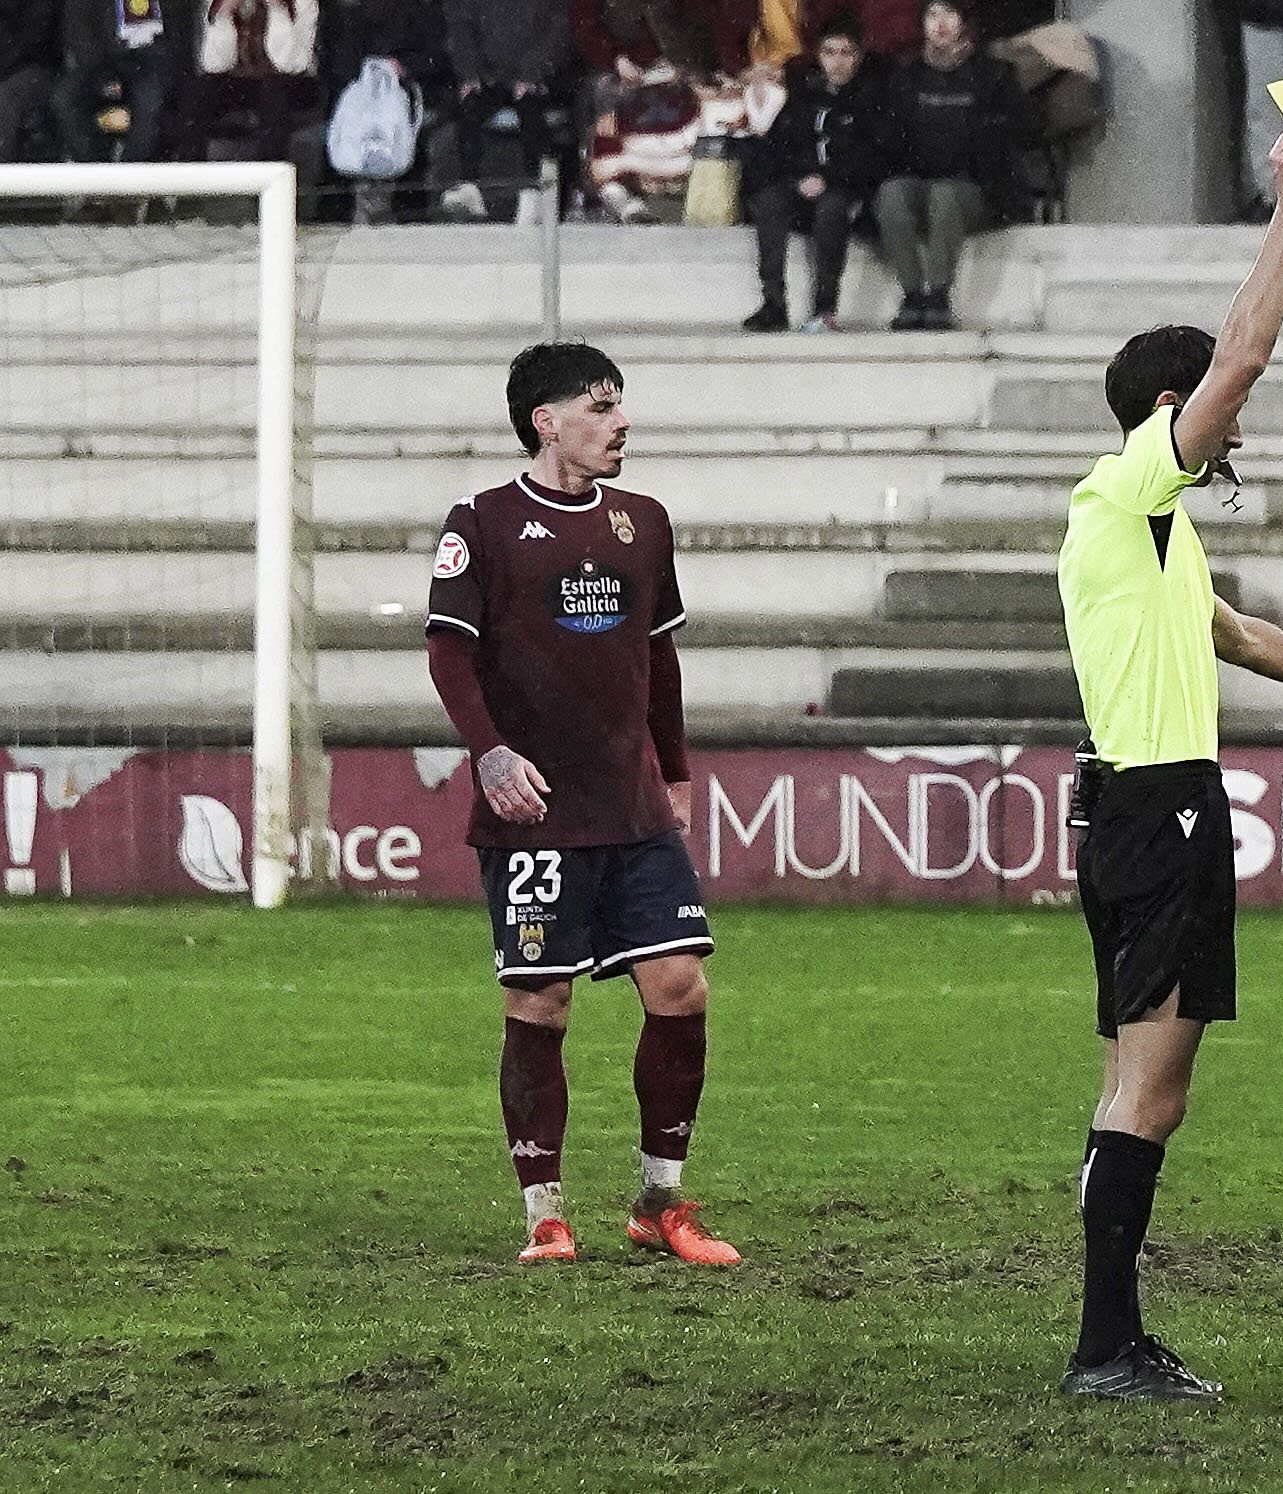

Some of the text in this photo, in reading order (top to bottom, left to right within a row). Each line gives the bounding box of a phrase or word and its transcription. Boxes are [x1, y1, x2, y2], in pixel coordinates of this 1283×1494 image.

[560, 577, 621, 595] Estrella
[563, 594, 619, 614] Galicia
[287, 824, 422, 882] nce
[709, 774, 1045, 880] MUNDO
[508, 850, 562, 904] 23
